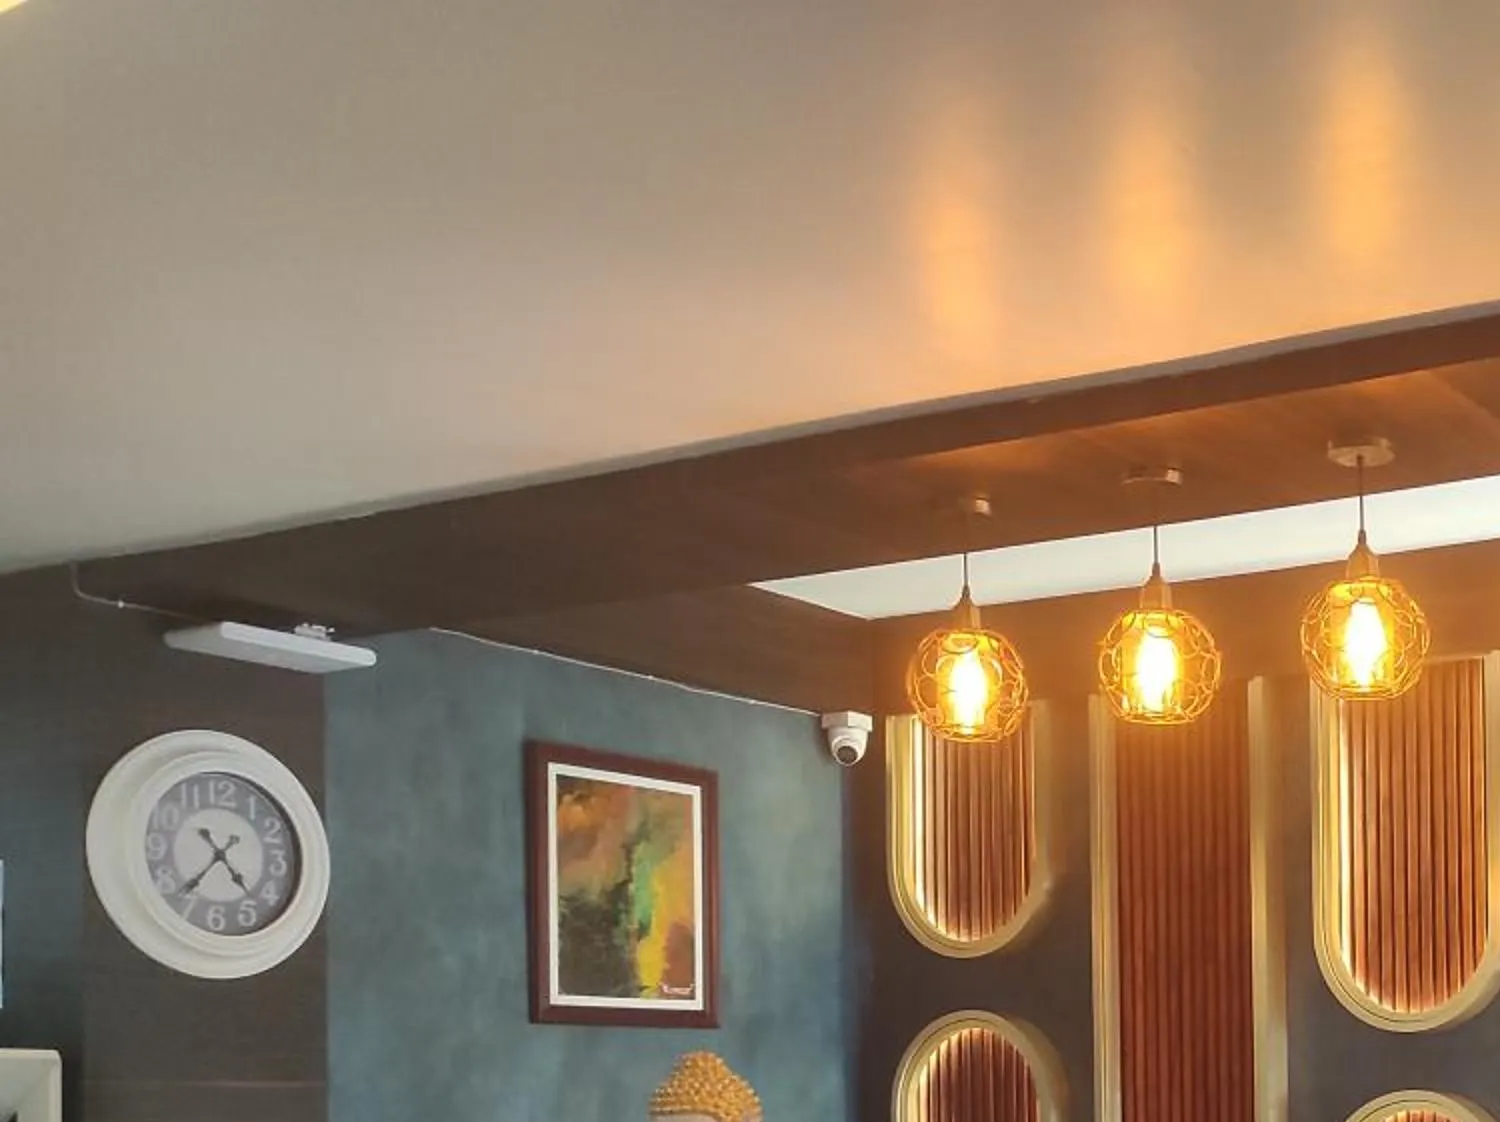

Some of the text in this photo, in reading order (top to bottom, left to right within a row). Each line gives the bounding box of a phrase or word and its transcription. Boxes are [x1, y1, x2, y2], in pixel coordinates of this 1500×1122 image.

[181, 783, 199, 808] 11
[209, 779, 237, 807] 12
[154, 803, 180, 830] 10
[264, 817, 282, 844] 2
[147, 832, 168, 861] 9
[269, 849, 287, 877] 3
[155, 864, 176, 895] 8
[259, 879, 280, 907] 4
[180, 889, 197, 921] 7
[206, 904, 226, 931] 6
[237, 900, 257, 927] 5
